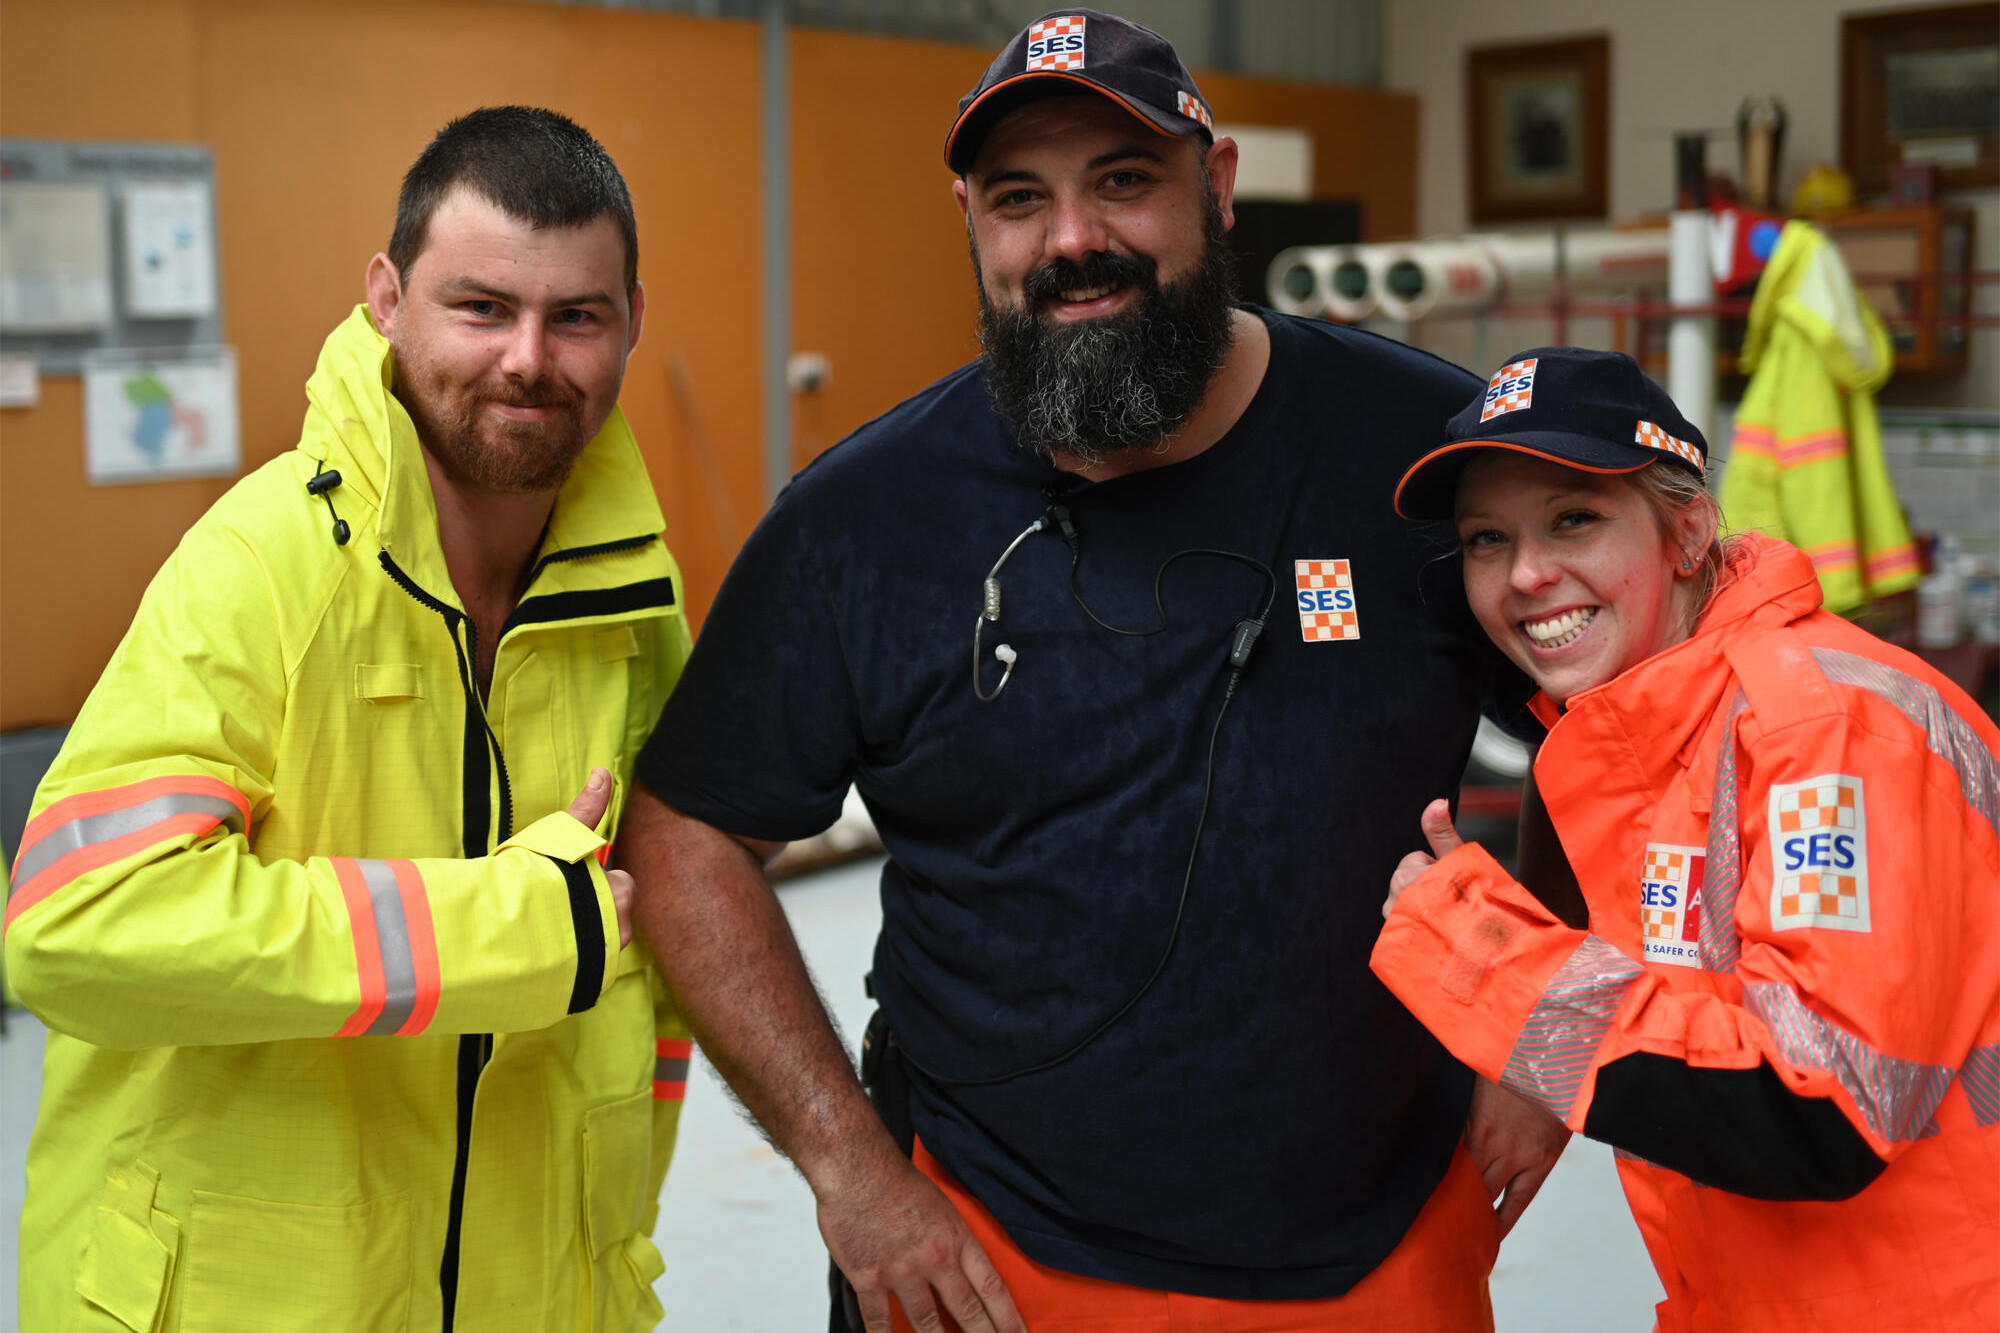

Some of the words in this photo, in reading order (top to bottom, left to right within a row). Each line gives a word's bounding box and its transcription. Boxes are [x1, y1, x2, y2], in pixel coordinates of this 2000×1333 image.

[1029, 35, 1083, 58] SES
[1486, 375, 1532, 402] SES
[1299, 590, 1353, 612] SES
[1784, 833, 1855, 871] SES
[1653, 944, 1684, 956] SAFER
